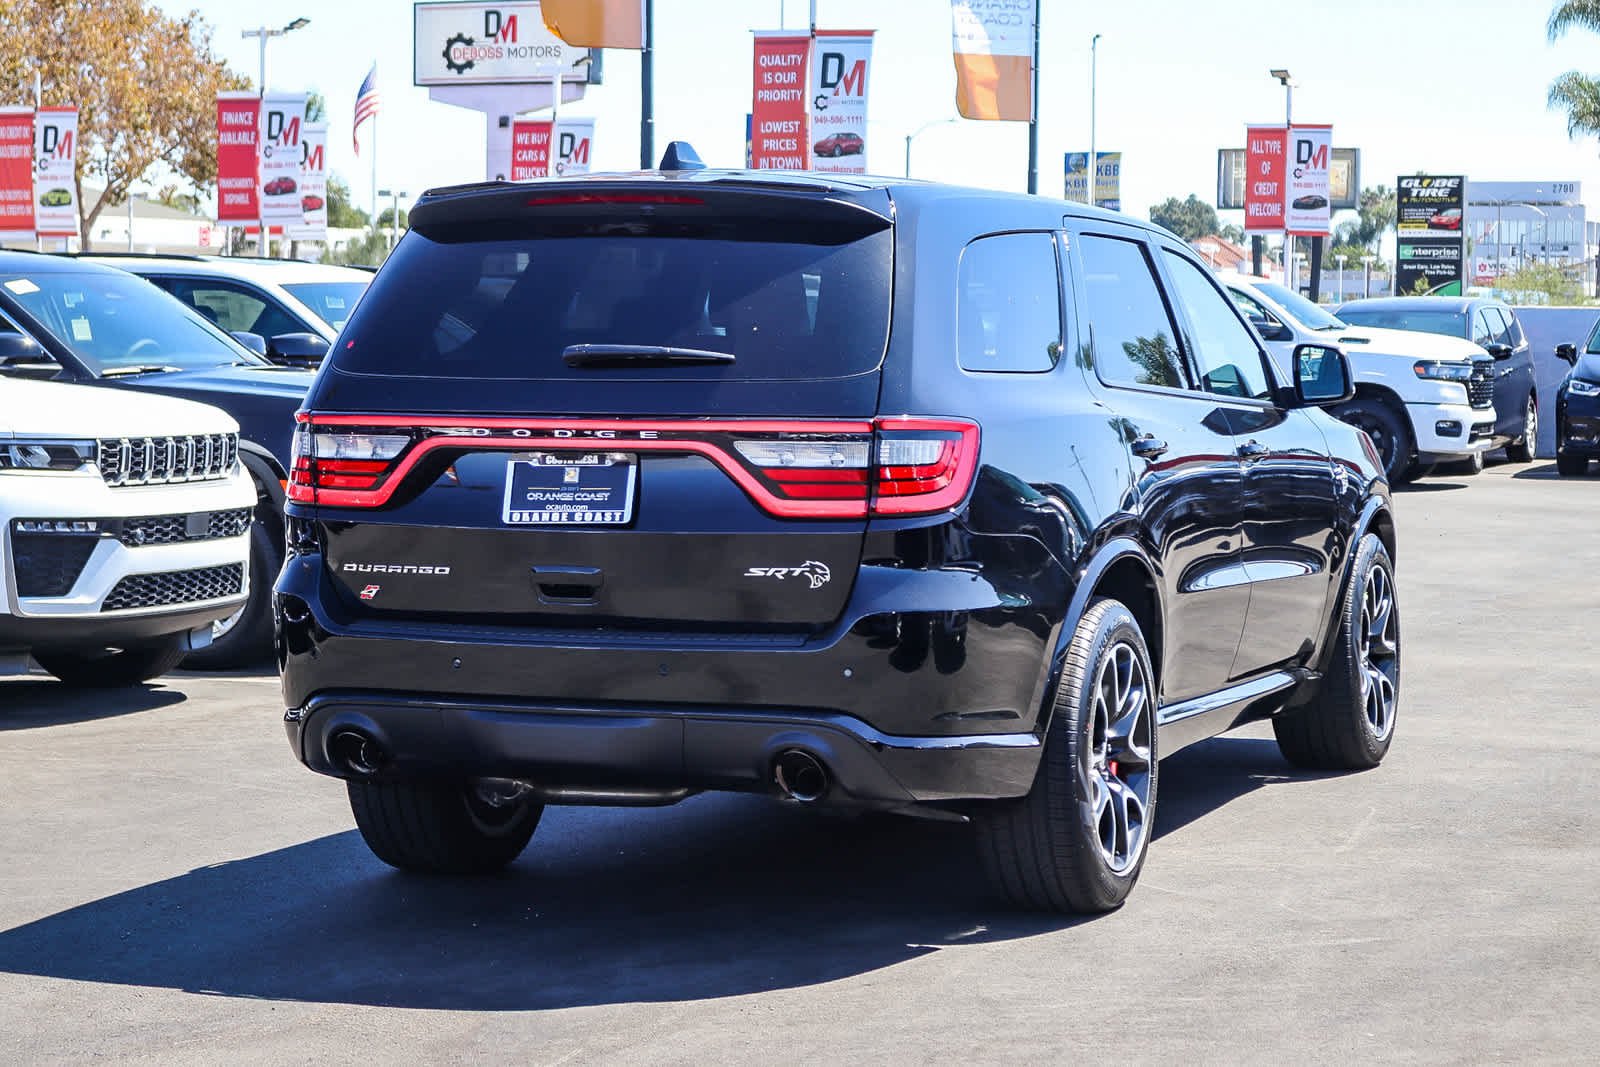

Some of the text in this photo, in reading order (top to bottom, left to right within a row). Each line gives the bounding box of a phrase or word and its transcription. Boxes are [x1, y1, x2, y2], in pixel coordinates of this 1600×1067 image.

[453, 46, 561, 61] DEBOSS MOTORS
[759, 54, 802, 67] QUALITY
[764, 72, 797, 84] IS OUR
[758, 89, 802, 102] PRIORITY
[222, 111, 254, 125] FINANCE
[760, 120, 801, 133] LOWEST
[220, 131, 256, 145] AVAILABLE
[516, 132, 549, 144] WE BUY
[763, 139, 797, 151] PRICES
[1252, 140, 1282, 154] ALL TYPE
[516, 150, 538, 162] CARS
[759, 156, 770, 169] IN
[771, 156, 803, 169] TOWN
[515, 166, 546, 179] TRUCKS
[1096, 164, 1119, 177] KBB
[1261, 161, 1271, 175] OF
[1254, 182, 1279, 196] CREDIT
[1400, 178, 1460, 188] GLOBE
[1410, 188, 1451, 197] TIRE
[1248, 203, 1281, 217] WELCOME
[1403, 246, 1458, 258] enterprise
[472, 428, 658, 439] DODGE
[526, 492, 611, 501] ORANGE COAST
[545, 503, 588, 512] ocauto.com
[511, 512, 622, 521] ORANGE COAST
[343, 562, 450, 575] DURANGO
[743, 567, 810, 580] SRT
